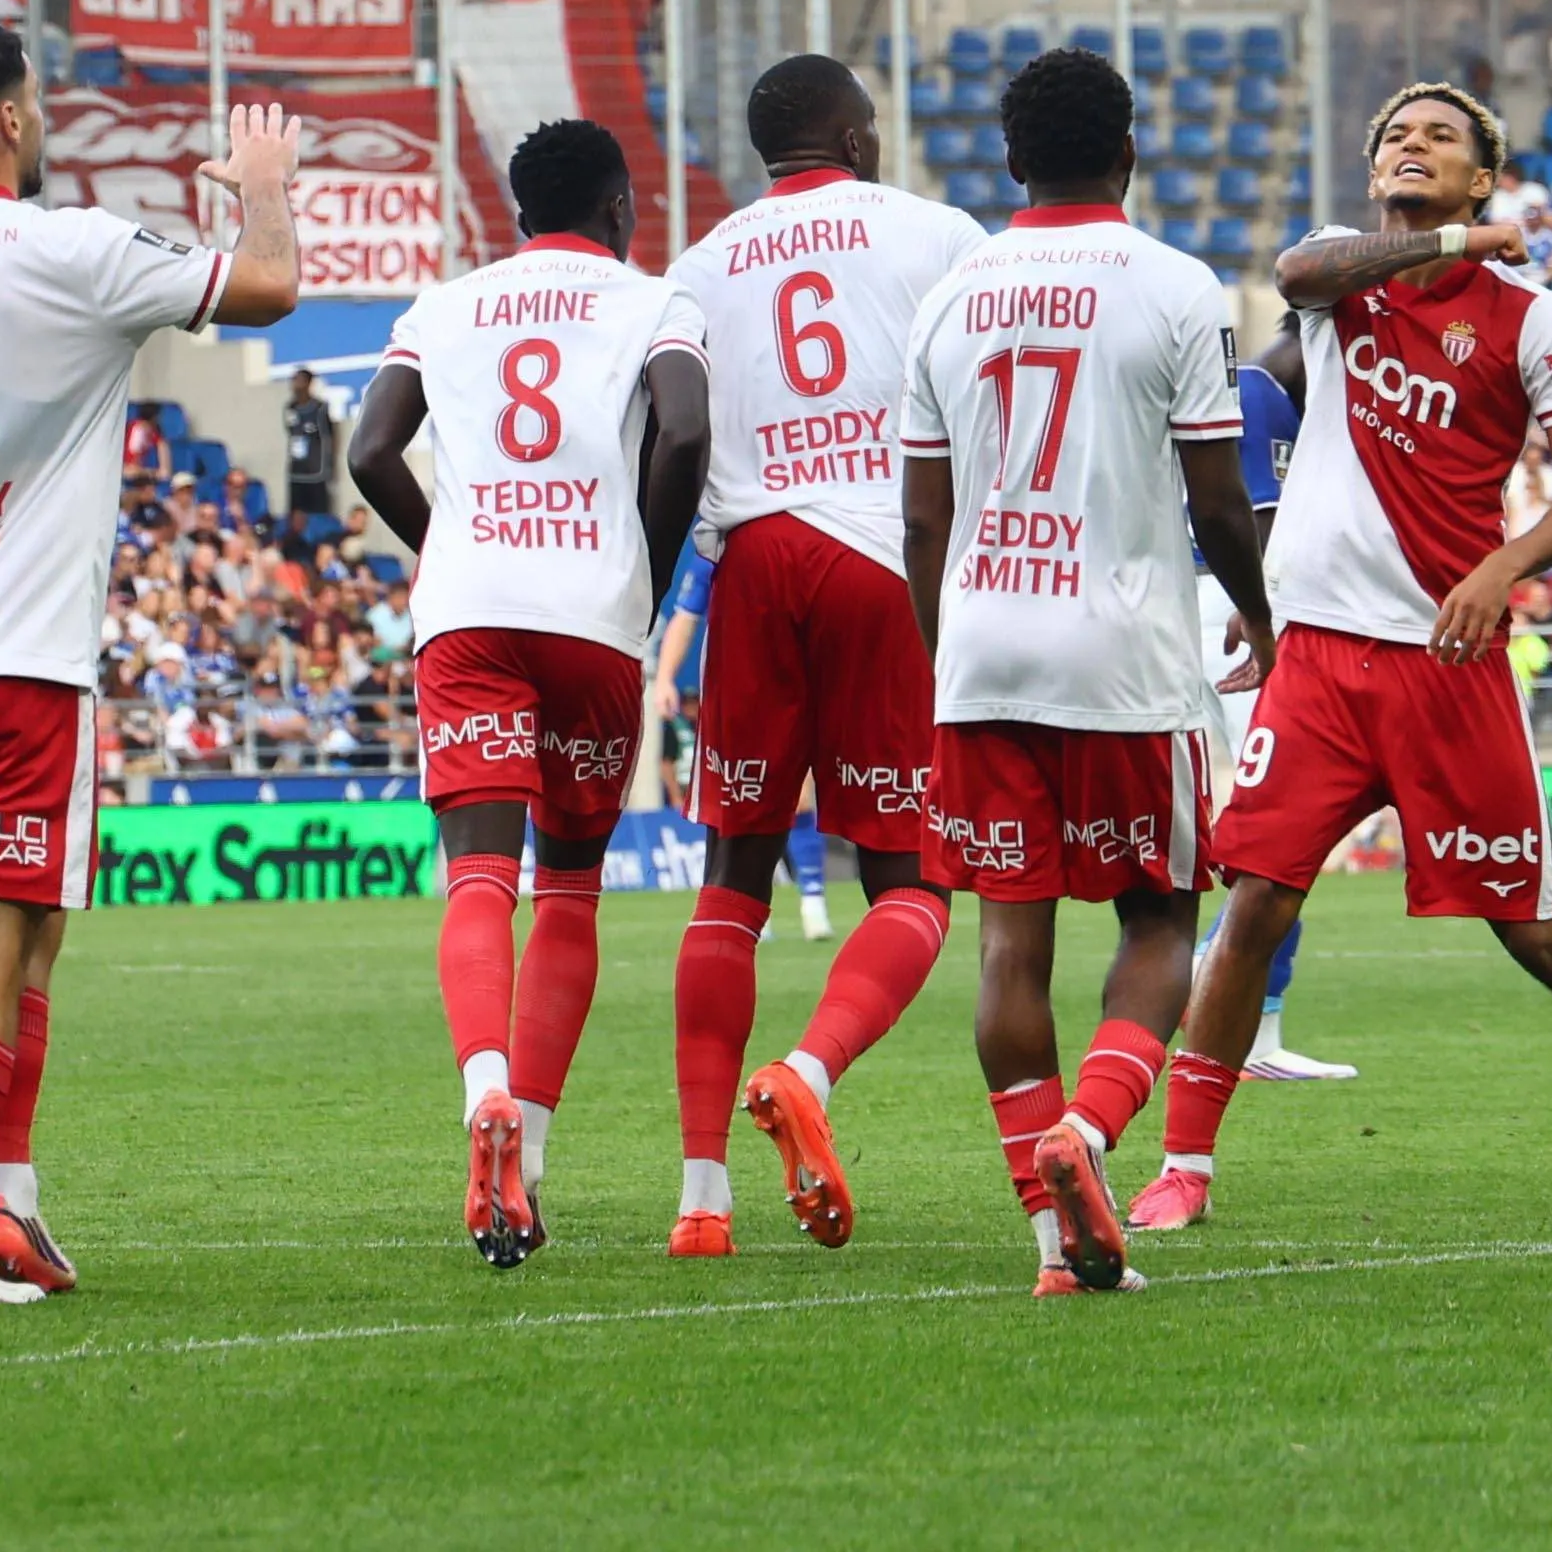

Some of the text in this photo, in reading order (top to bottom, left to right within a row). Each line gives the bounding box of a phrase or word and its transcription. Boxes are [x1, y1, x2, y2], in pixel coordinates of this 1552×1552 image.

[726, 218, 870, 277] ZAKARIA
[1030, 249, 1130, 269] OLUFSEN
[474, 289, 599, 328] LAMINE
[966, 285, 1097, 335] IDUMBO
[771, 270, 848, 397] 6
[496, 338, 562, 463] 8
[977, 345, 1082, 493] 17
[755, 407, 888, 458] TEDDY
[1351, 402, 1416, 454] MOACO
[762, 447, 892, 493] SMITH
[469, 477, 599, 515] TEDDY
[471, 515, 599, 552] SMITH
[976, 510, 1083, 552] EDDY
[959, 553, 1081, 598] SMITH
[427, 711, 535, 754] SIMPLICI
[482, 738, 536, 761] CAR
[574, 762, 623, 781] CAR
[1063, 813, 1156, 849] IMPLICI
[1425, 825, 1539, 865] vbet
[214, 818, 427, 902] Sofitex
[962, 847, 1026, 871] CAR
